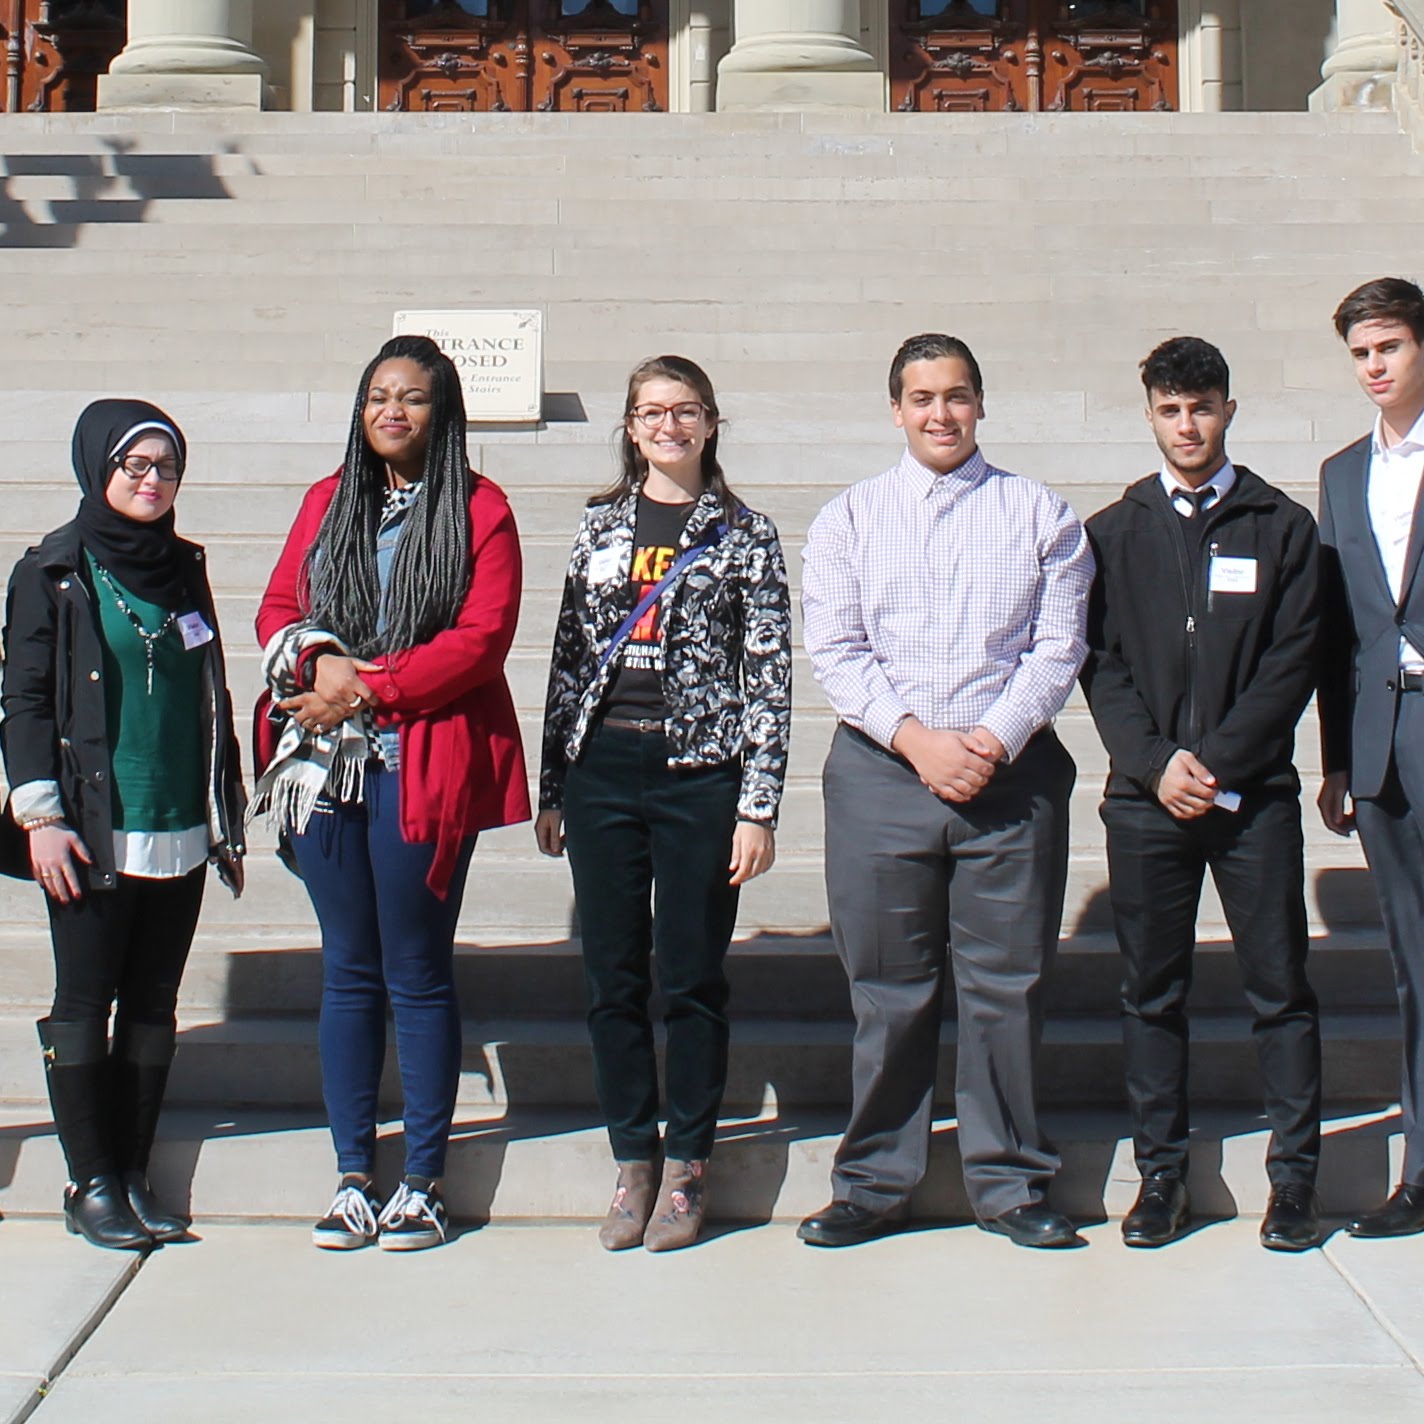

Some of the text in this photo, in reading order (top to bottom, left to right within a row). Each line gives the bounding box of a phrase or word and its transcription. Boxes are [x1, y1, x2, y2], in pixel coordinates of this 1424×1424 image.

[426, 328, 449, 336] This
[436, 338, 524, 350] TRANCE
[452, 355, 507, 367] OSED
[471, 374, 521, 382] Entrance
[468, 385, 501, 393] Stairs
[625, 657, 651, 669] STILL
